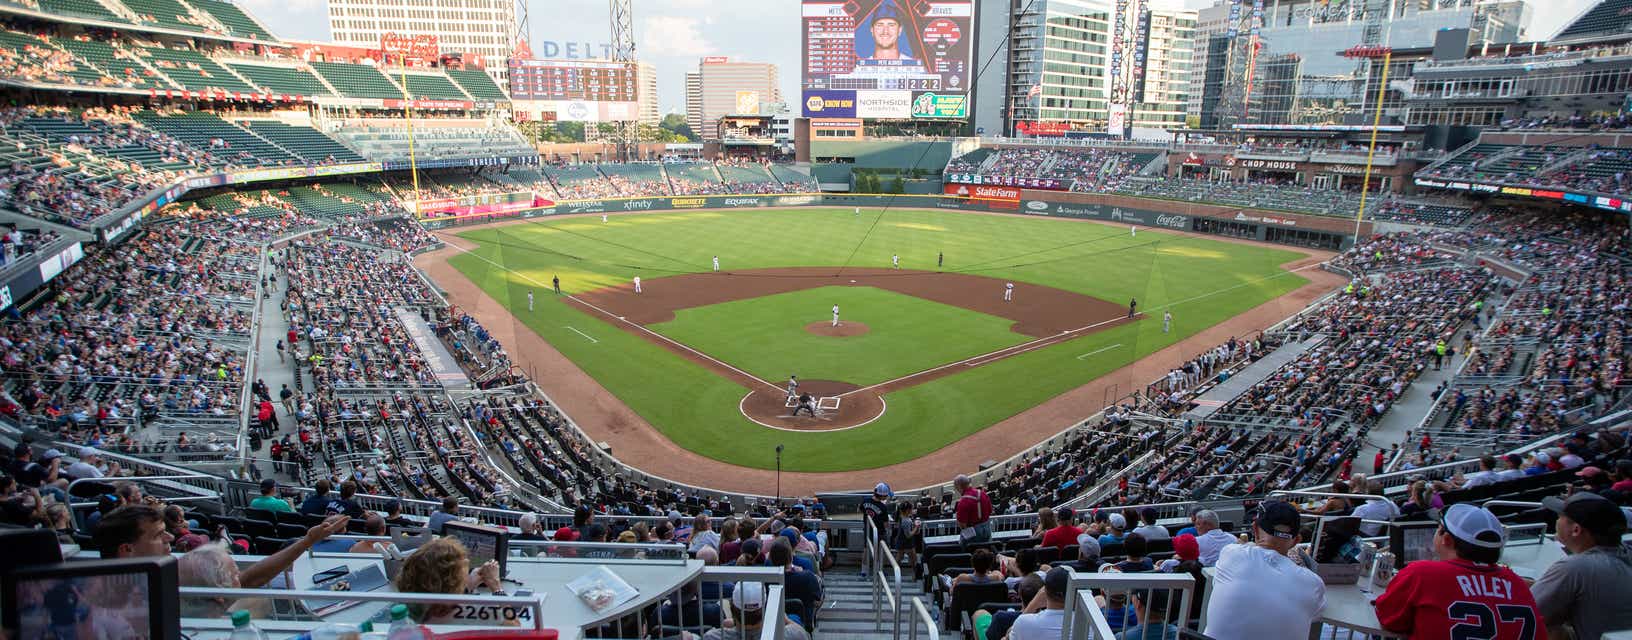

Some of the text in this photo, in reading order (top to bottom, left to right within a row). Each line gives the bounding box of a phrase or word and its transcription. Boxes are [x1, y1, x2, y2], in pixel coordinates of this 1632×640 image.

[931, 7, 953, 15] BRAVES
[910, 79, 939, 88] 2 2 2
[1242, 159, 1297, 170] CHOP HOUSE
[623, 198, 653, 210] xfinity
[724, 198, 759, 206] EQUIFAX
[1456, 575, 1513, 600] RILEY
[1447, 600, 1537, 640] 27
